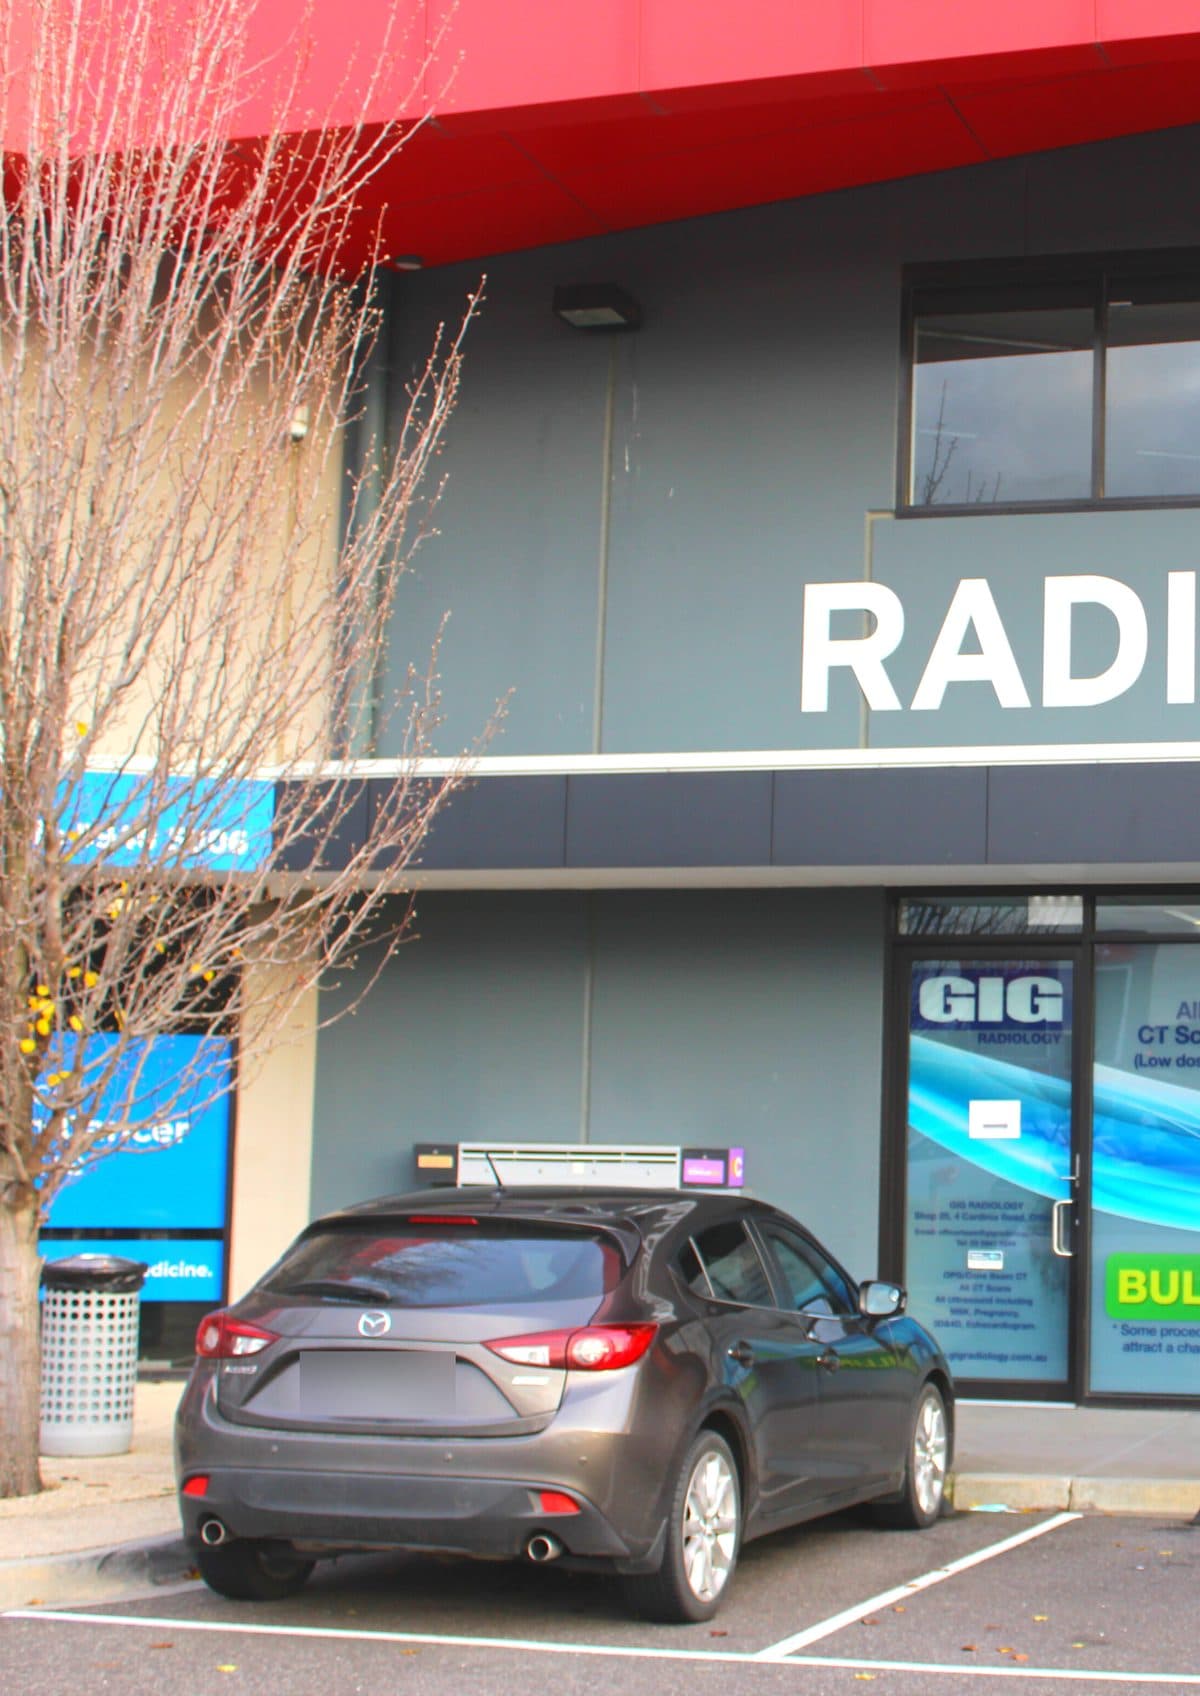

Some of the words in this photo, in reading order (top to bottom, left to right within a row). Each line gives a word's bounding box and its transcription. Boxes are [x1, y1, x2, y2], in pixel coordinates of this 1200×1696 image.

[919, 976, 1063, 1023] GIG
[977, 1032, 1062, 1045] RADIOLOGY
[1138, 1025, 1169, 1044] CT
[1134, 1053, 1172, 1070] (Low
[1120, 1324, 1157, 1338] Some
[1122, 1341, 1163, 1354] attract
[1166, 1344, 1174, 1354] a
